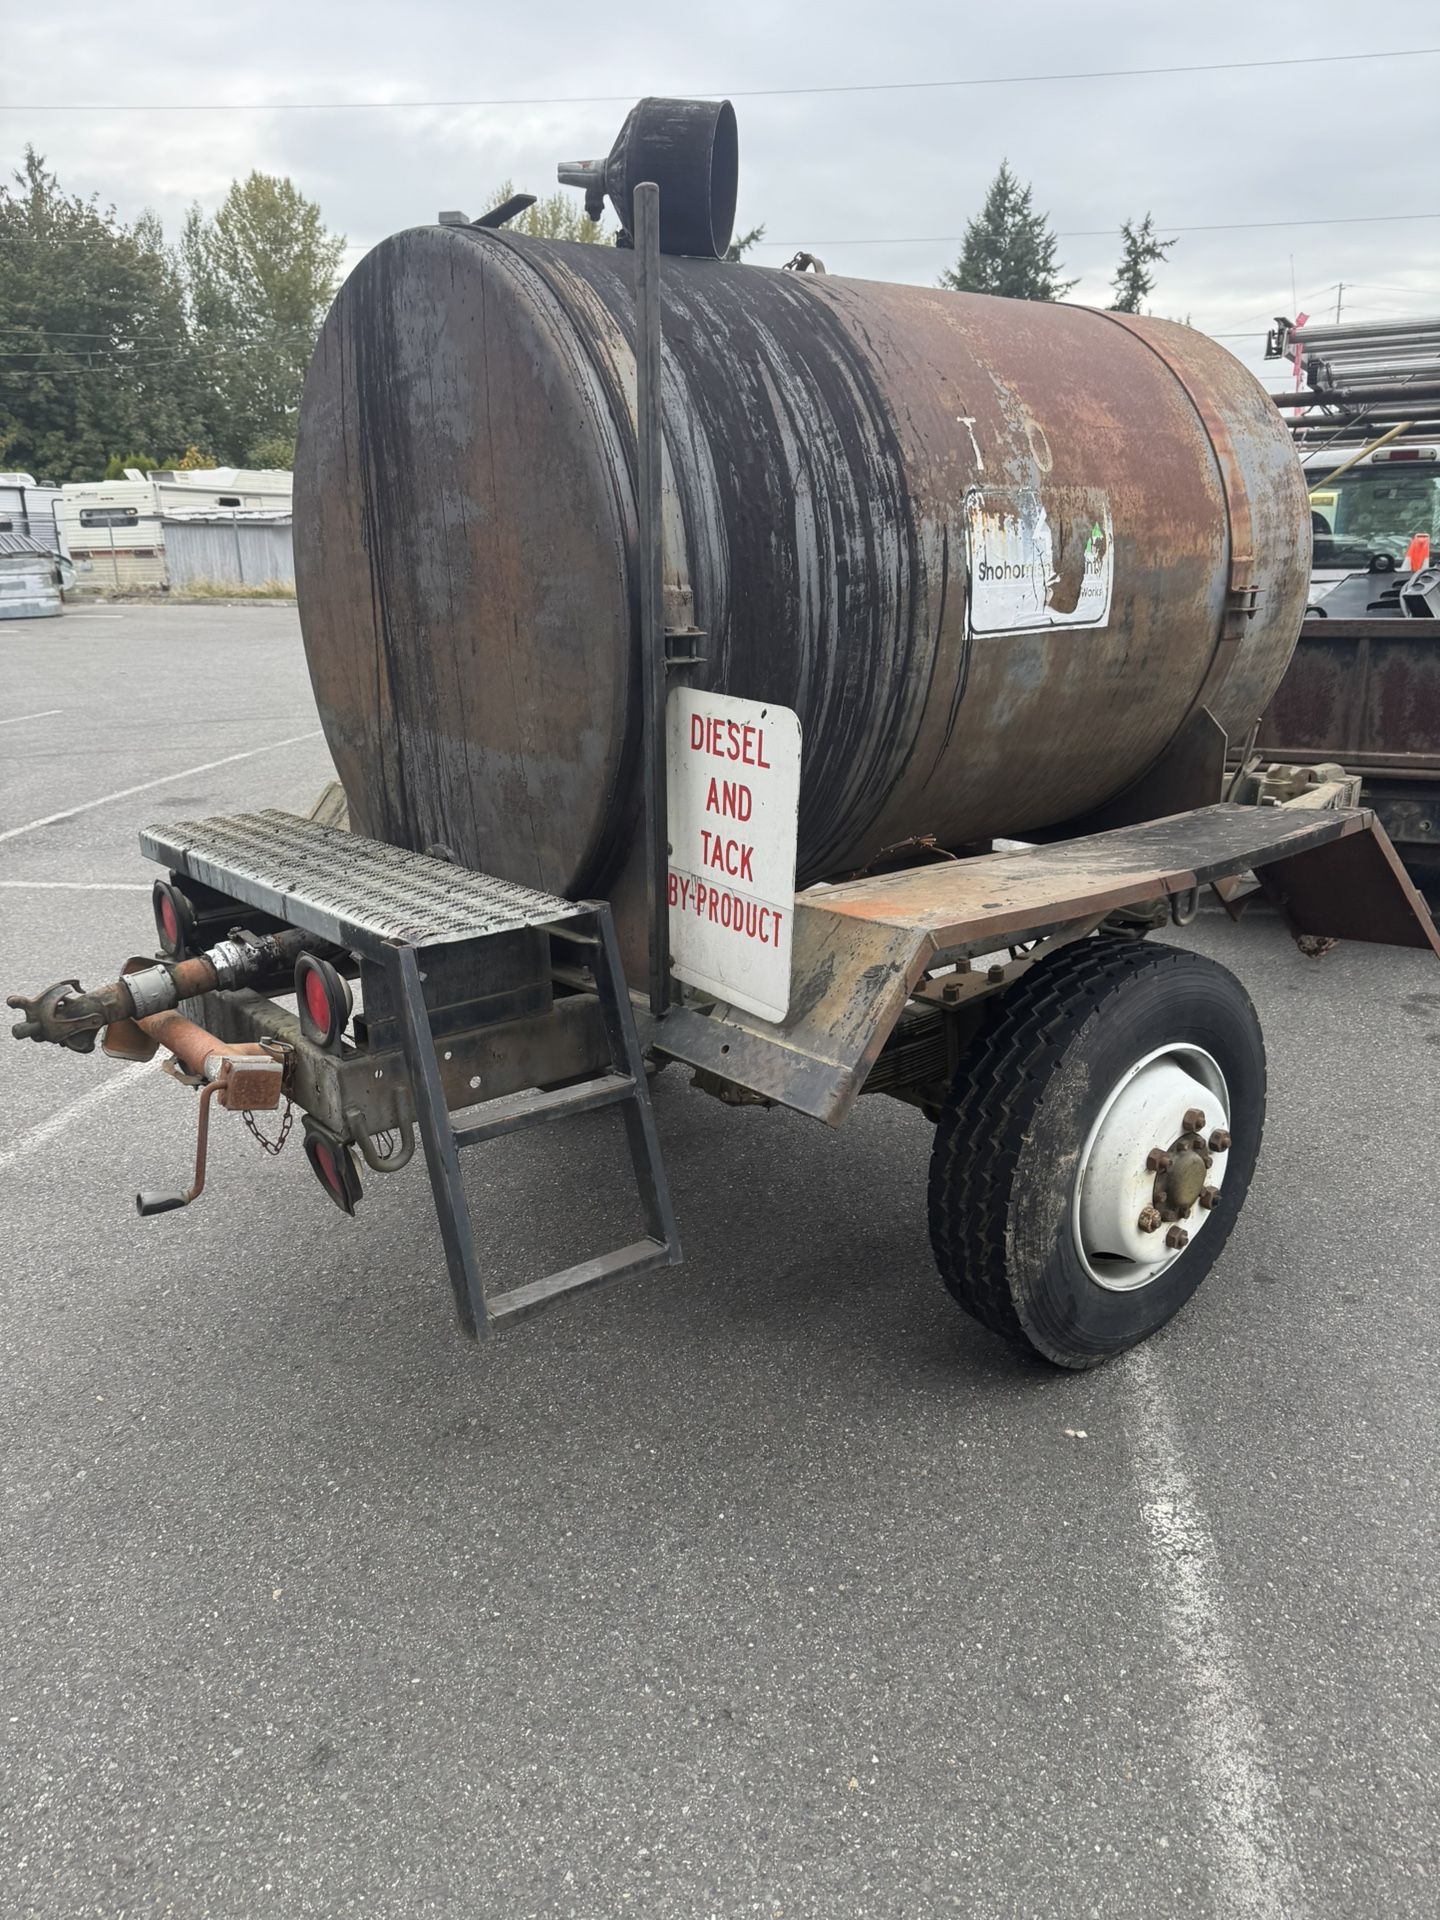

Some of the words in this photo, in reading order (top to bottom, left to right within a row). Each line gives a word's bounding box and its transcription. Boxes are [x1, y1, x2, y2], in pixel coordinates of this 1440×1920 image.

[979, 561, 1051, 581] Snoho
[691, 714, 770, 769] DIESEL
[706, 777, 752, 822] AND
[701, 830, 753, 882] TACK
[668, 872, 782, 948] BY-PRODUCT
